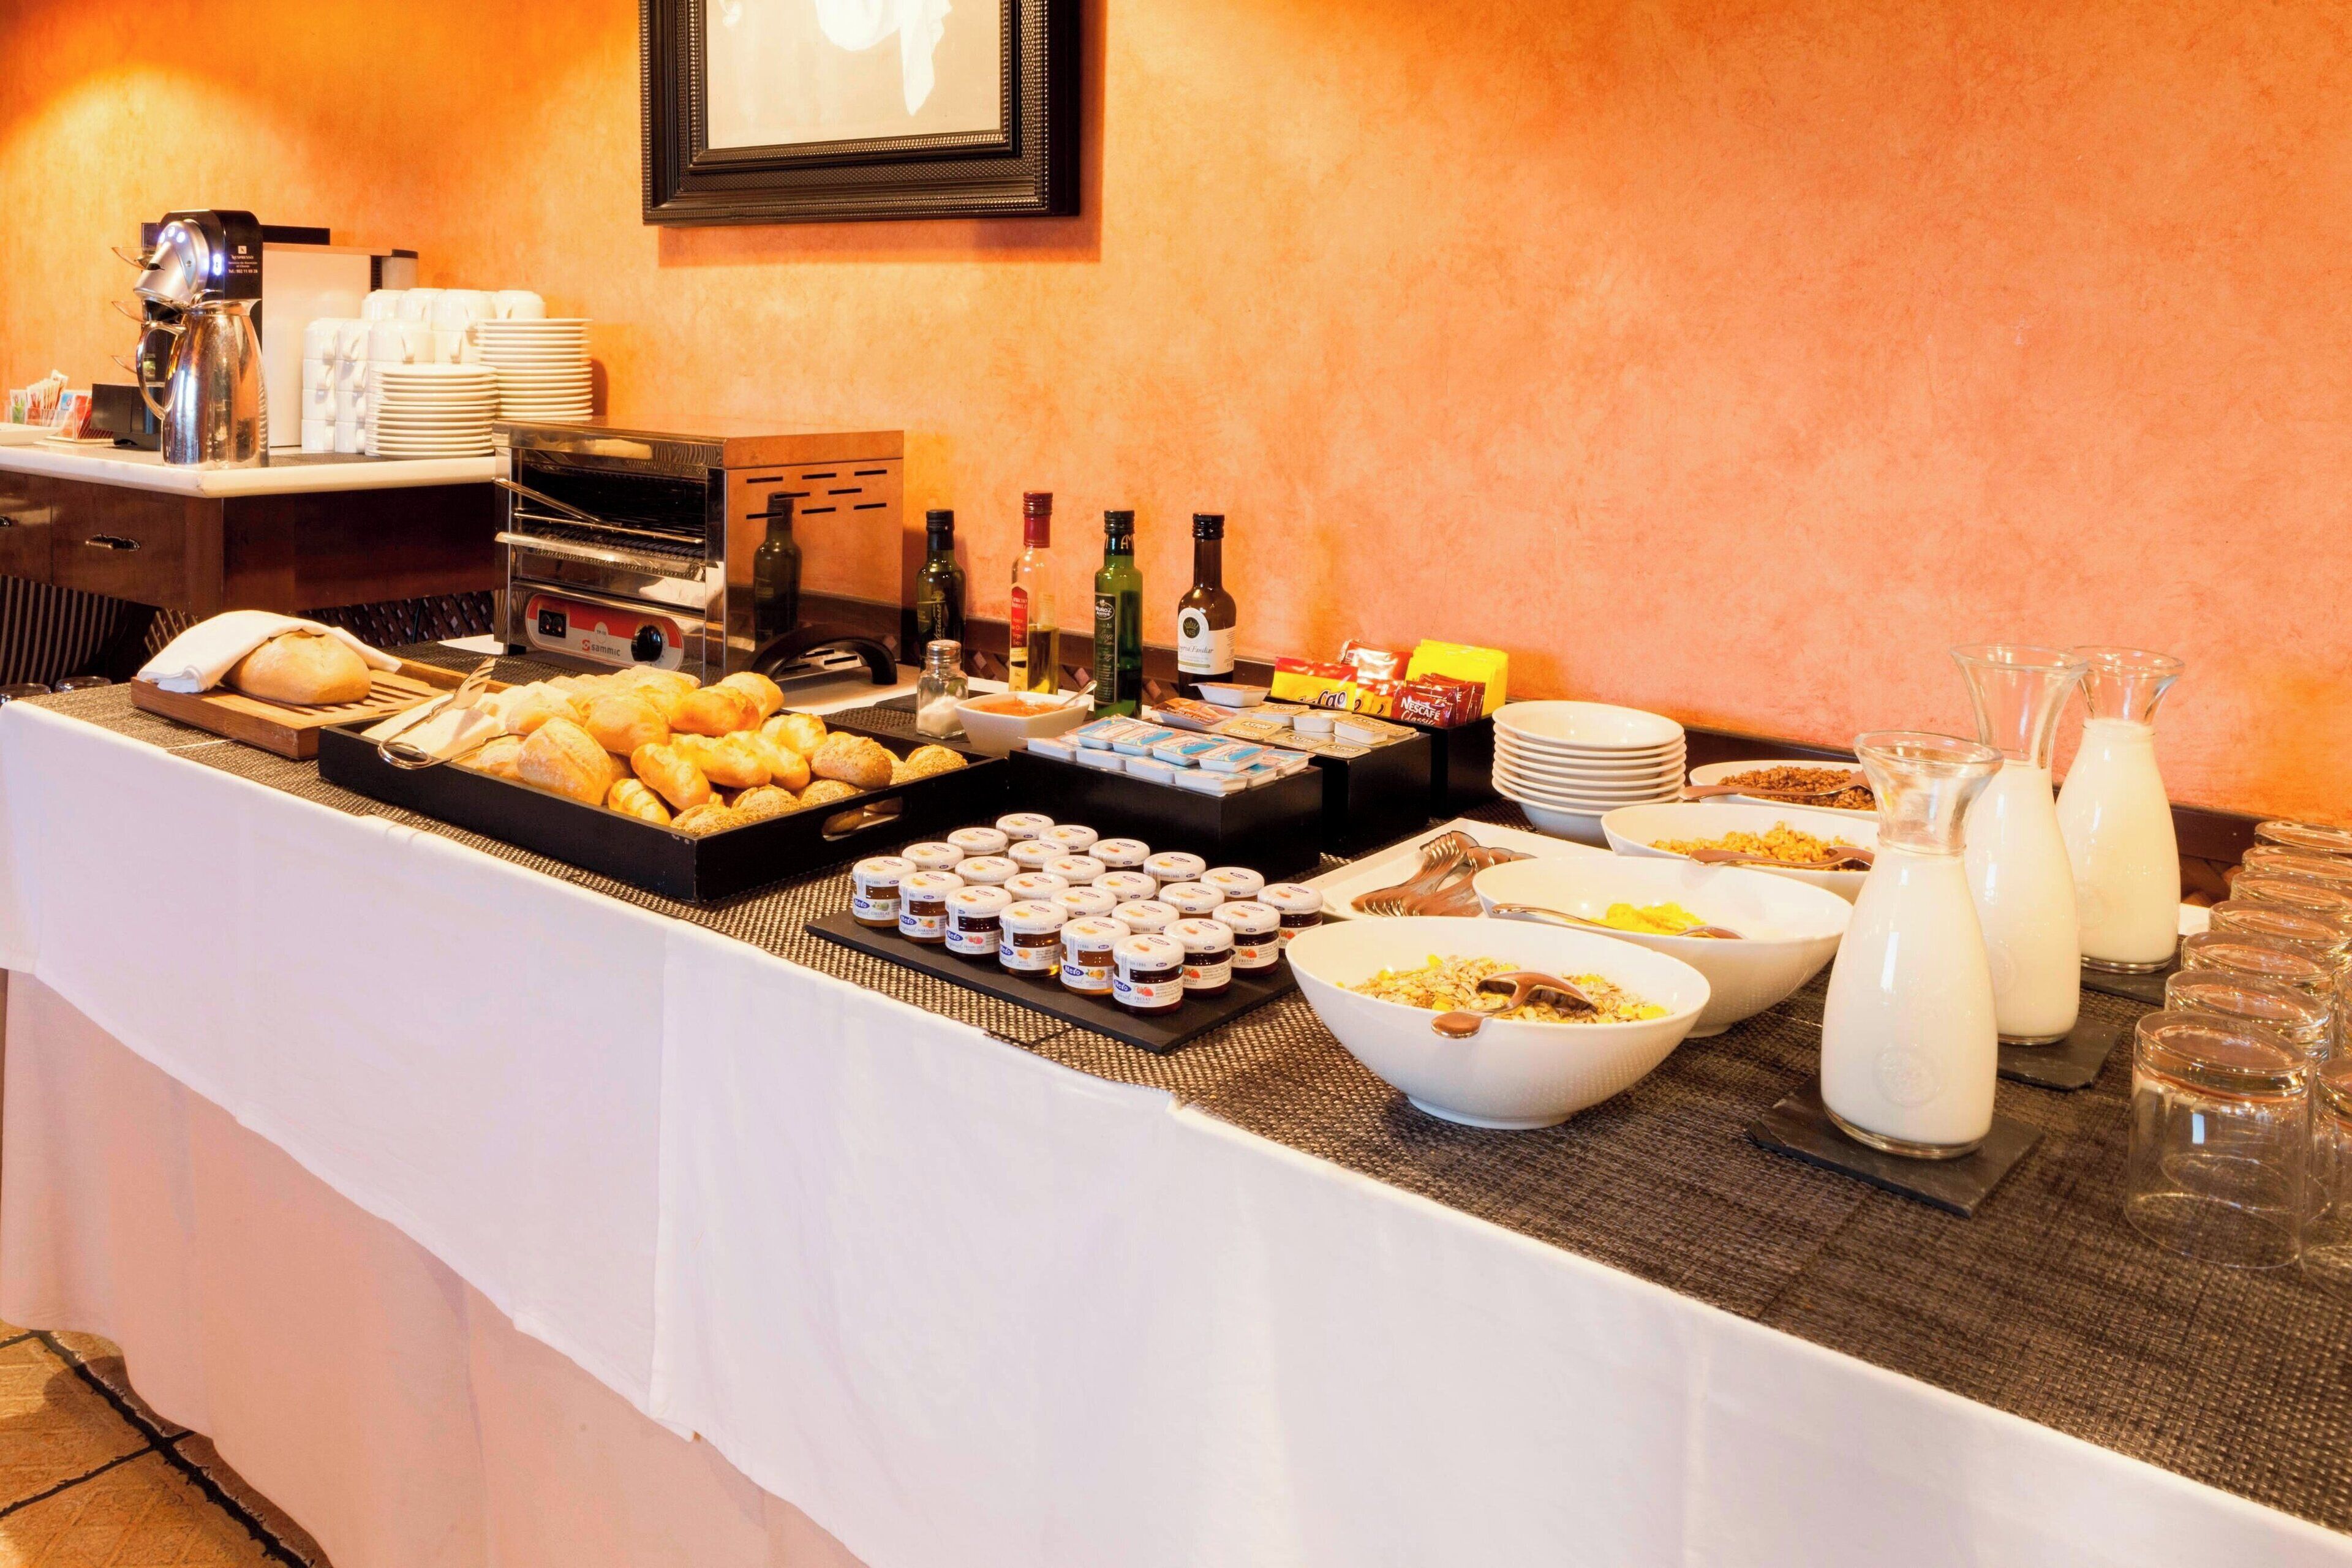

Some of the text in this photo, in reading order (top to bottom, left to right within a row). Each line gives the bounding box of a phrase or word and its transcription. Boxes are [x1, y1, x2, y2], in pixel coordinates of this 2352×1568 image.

[591, 643, 620, 657] sammic
[1401, 697, 1441, 720] NESCAFÉ
[854, 899, 867, 908] Hero
[900, 915, 915, 925] Hero
[946, 930, 960, 941] Hero
[1064, 966, 1081, 976] Hero
[1114, 980, 1128, 992] Hero
